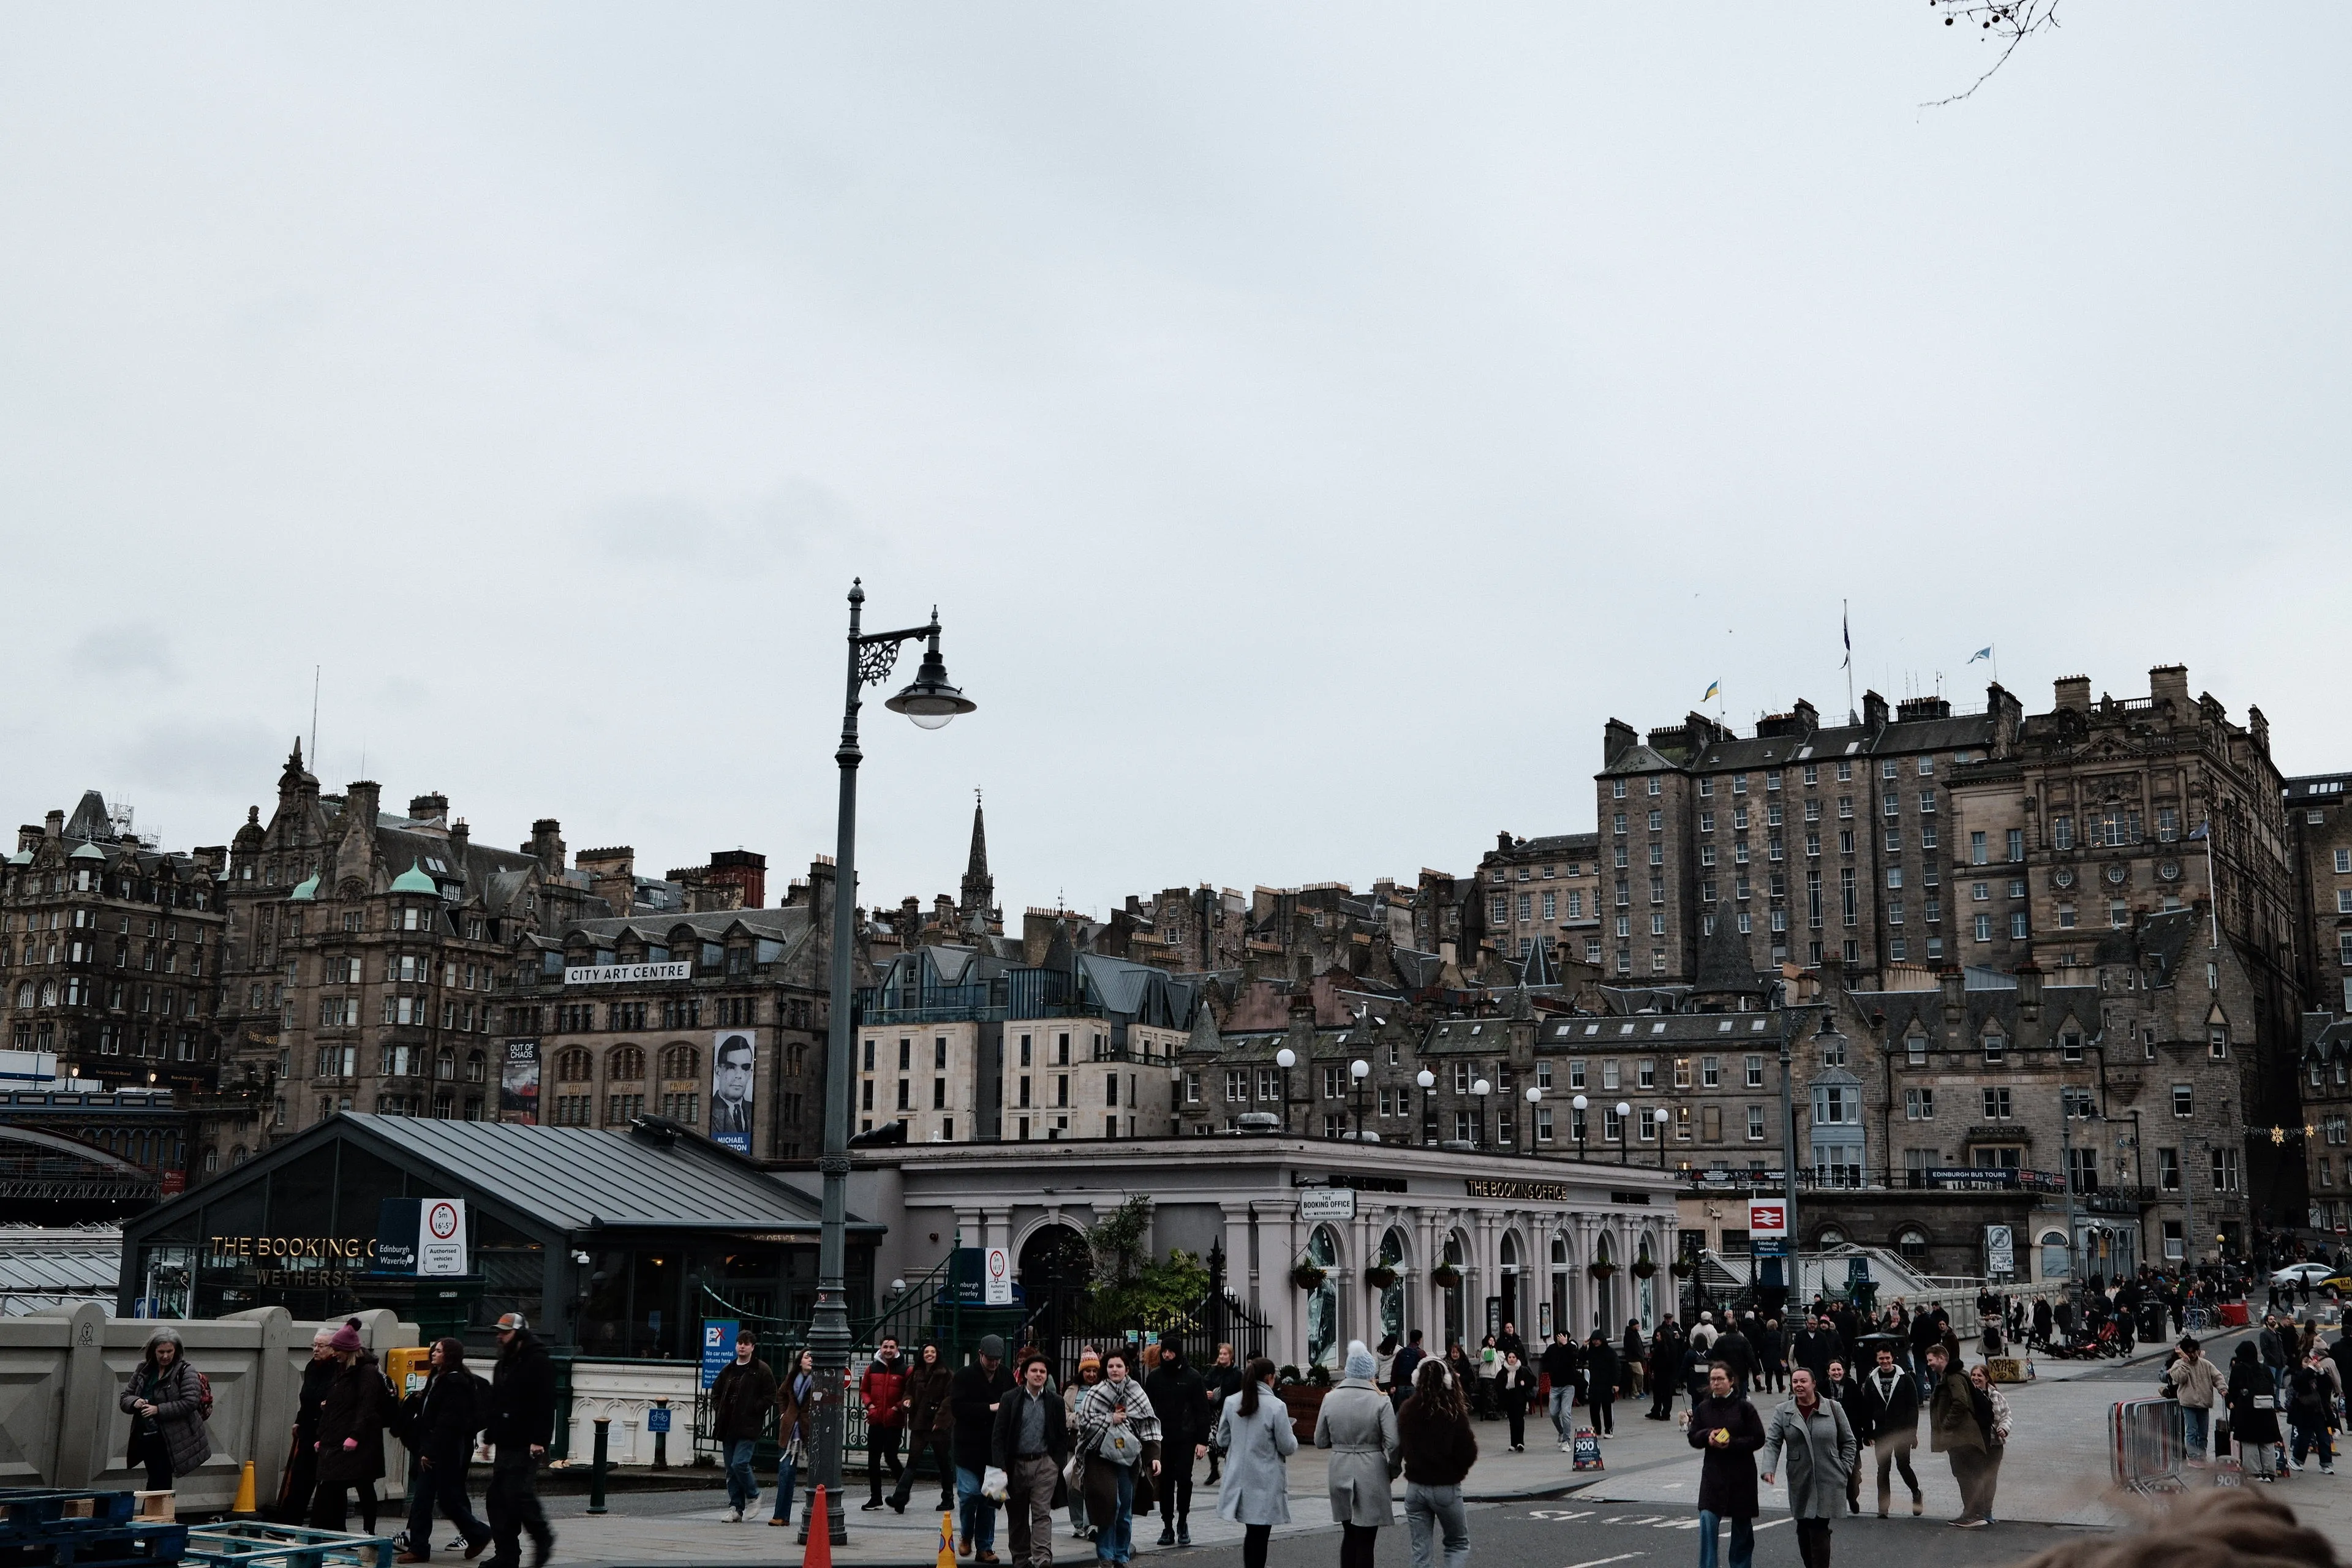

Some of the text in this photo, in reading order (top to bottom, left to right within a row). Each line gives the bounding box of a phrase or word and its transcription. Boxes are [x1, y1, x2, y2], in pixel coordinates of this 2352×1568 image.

[571, 965, 684, 981] CITY ART CENTRE
[248, 1031, 278, 1044] THE SCO
[567, 1082, 694, 1094] CITY ART CENTRE
[1468, 1180, 1567, 1200] THE BOOKING OFFICE
[211, 1236, 251, 1256] THE
[257, 1237, 360, 1257] BOOKING
[380, 1245, 410, 1254] Edinburgh
[380, 1256, 408, 1267] Waverley
[1576, 1441, 1594, 1452] 900
[2217, 1474, 2241, 1487] 900
